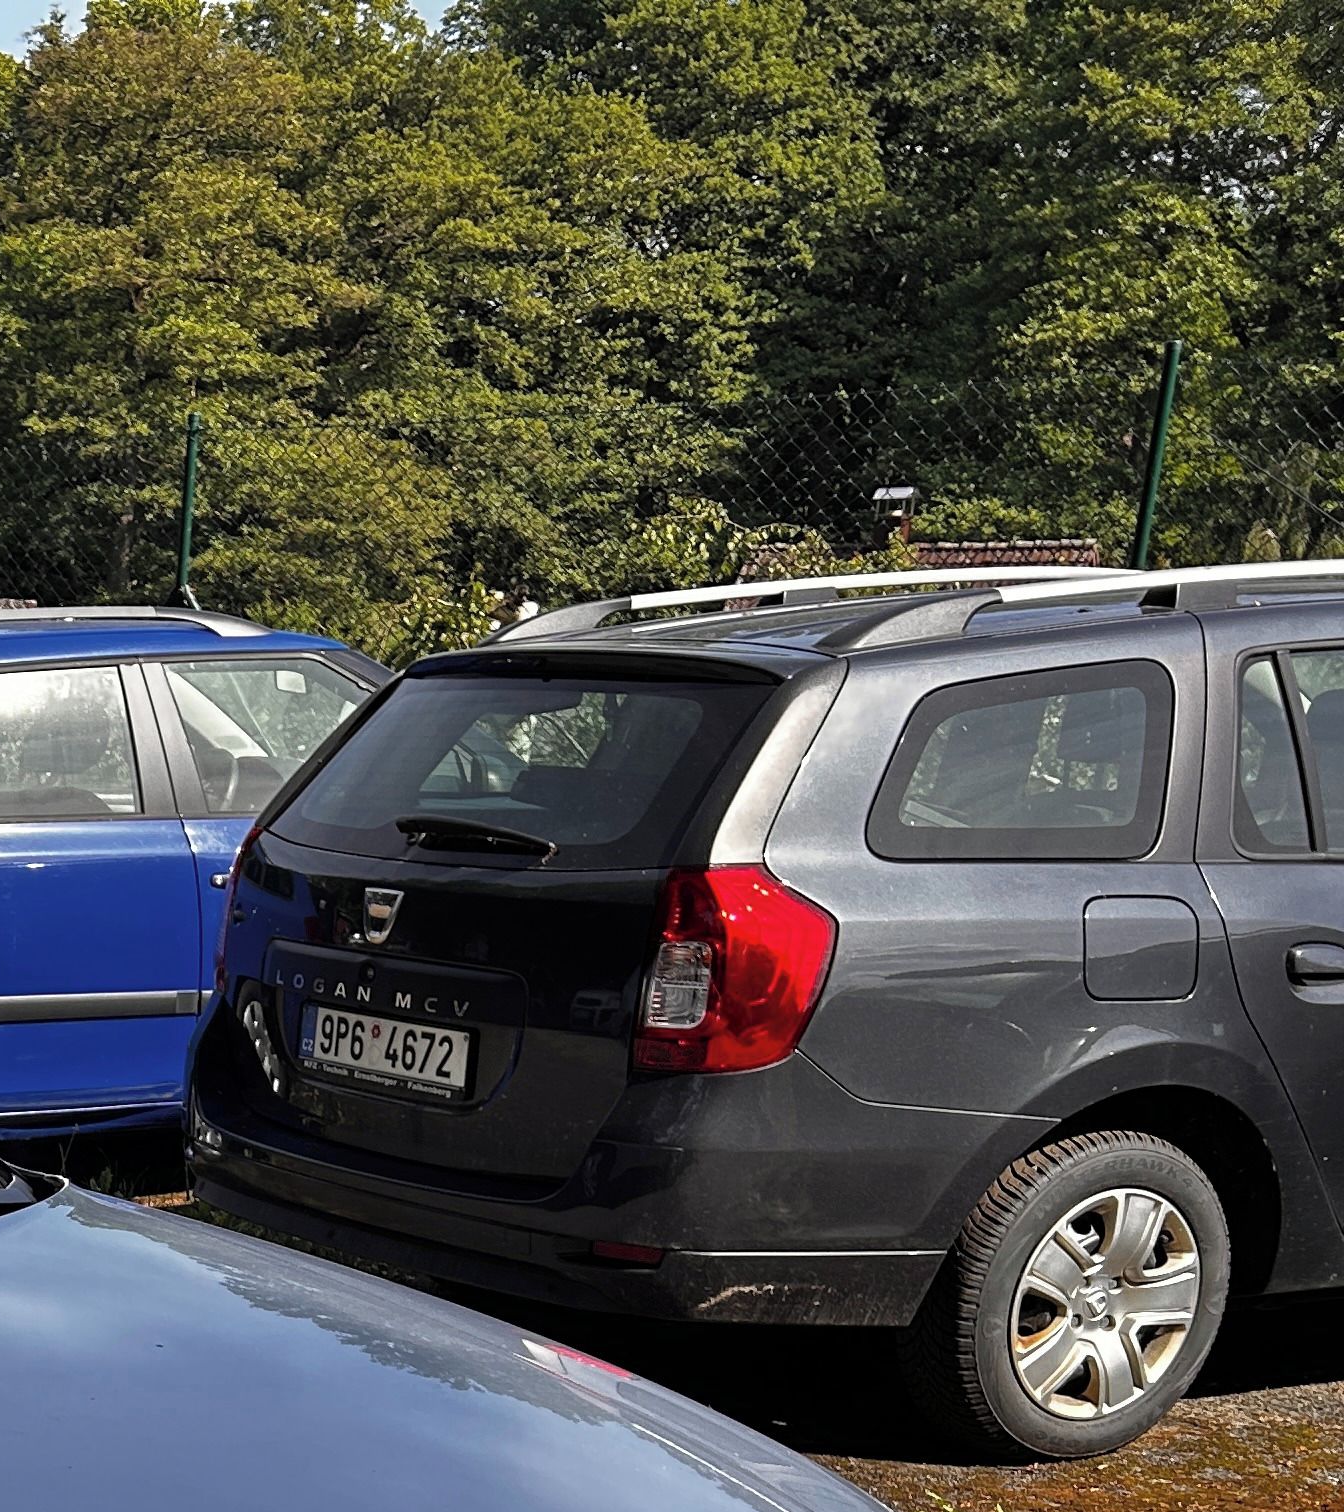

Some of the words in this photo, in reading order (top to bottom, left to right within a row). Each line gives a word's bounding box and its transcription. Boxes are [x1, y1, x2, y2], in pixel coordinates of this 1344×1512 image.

[276, 970, 370, 1002] LOGAN
[395, 992, 469, 1017] MCV
[302, 1039, 314, 1052] CZ
[320, 1014, 365, 1061] 9P6
[384, 1026, 453, 1079] 4672
